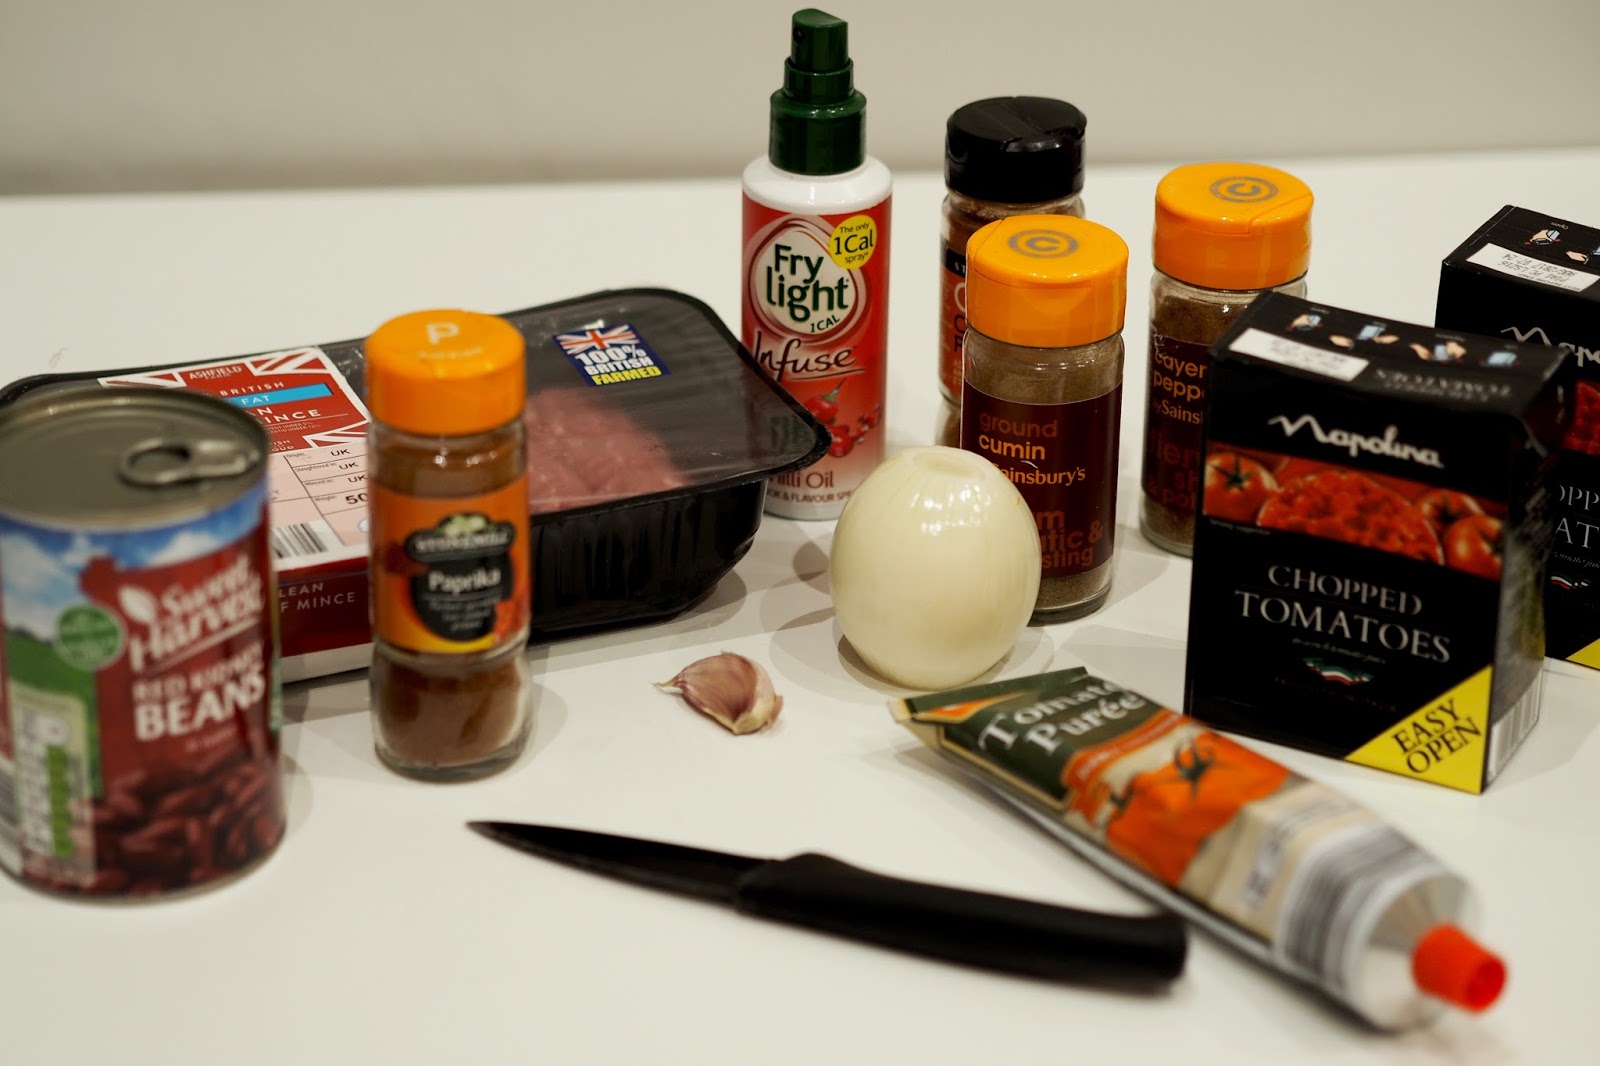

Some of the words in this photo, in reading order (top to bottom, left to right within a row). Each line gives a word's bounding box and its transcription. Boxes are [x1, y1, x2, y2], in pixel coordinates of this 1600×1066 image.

[839, 225, 854, 234] The
[855, 222, 870, 232] only
[833, 229, 874, 255] 1Cal
[774, 243, 824, 284] Fry
[766, 276, 848, 322] light
[426, 322, 460, 345] P
[810, 314, 841, 333] 1CAL
[575, 344, 647, 366] 100%
[754, 331, 857, 383] Infuse
[189, 365, 243, 380] ASHFIELD
[584, 357, 654, 376] BRITISH
[591, 366, 662, 386] FARMED
[219, 381, 285, 397] BRITISH
[1153, 370, 1204, 401] pepp
[241, 395, 270, 405] FAT
[263, 409, 321, 424] INCE
[1160, 399, 1204, 425] Sains
[979, 412, 1059, 438] ground
[330, 449, 351, 457] UK
[979, 434, 1046, 461] cumin
[339, 462, 359, 470] UK
[347, 474, 368, 483] UK
[805, 470, 834, 490] Oil
[297, 591, 356, 611] MINCE
[1267, 565, 1422, 615] CHOPPED
[1234, 590, 1451, 664] TOMATOES
[134, 668, 266, 742] BEANS
[1392, 697, 1460, 755] EASY
[1406, 716, 1483, 774] OPEN
